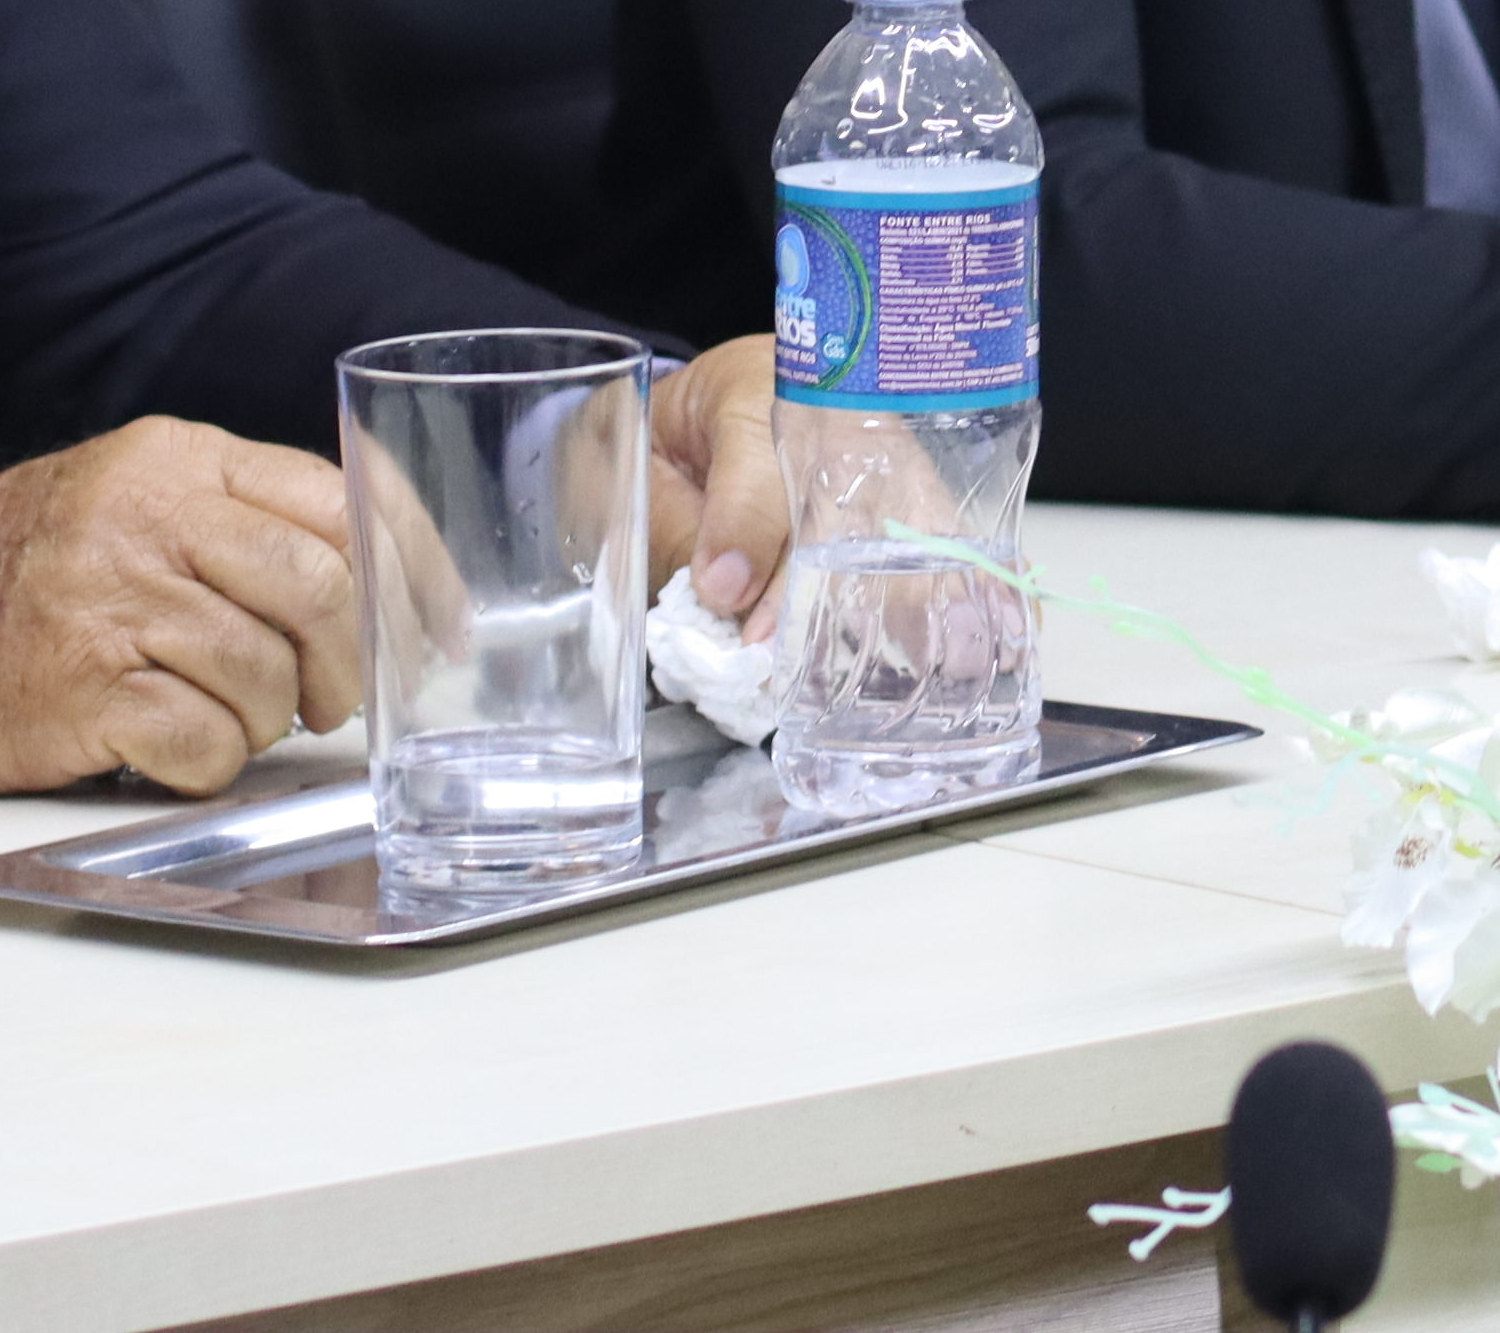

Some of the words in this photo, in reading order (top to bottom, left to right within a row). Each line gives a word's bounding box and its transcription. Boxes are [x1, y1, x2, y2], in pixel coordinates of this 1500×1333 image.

[879, 216, 921, 227] FONTE
[924, 214, 963, 227] ENTRE
[966, 213, 991, 226] RIOS
